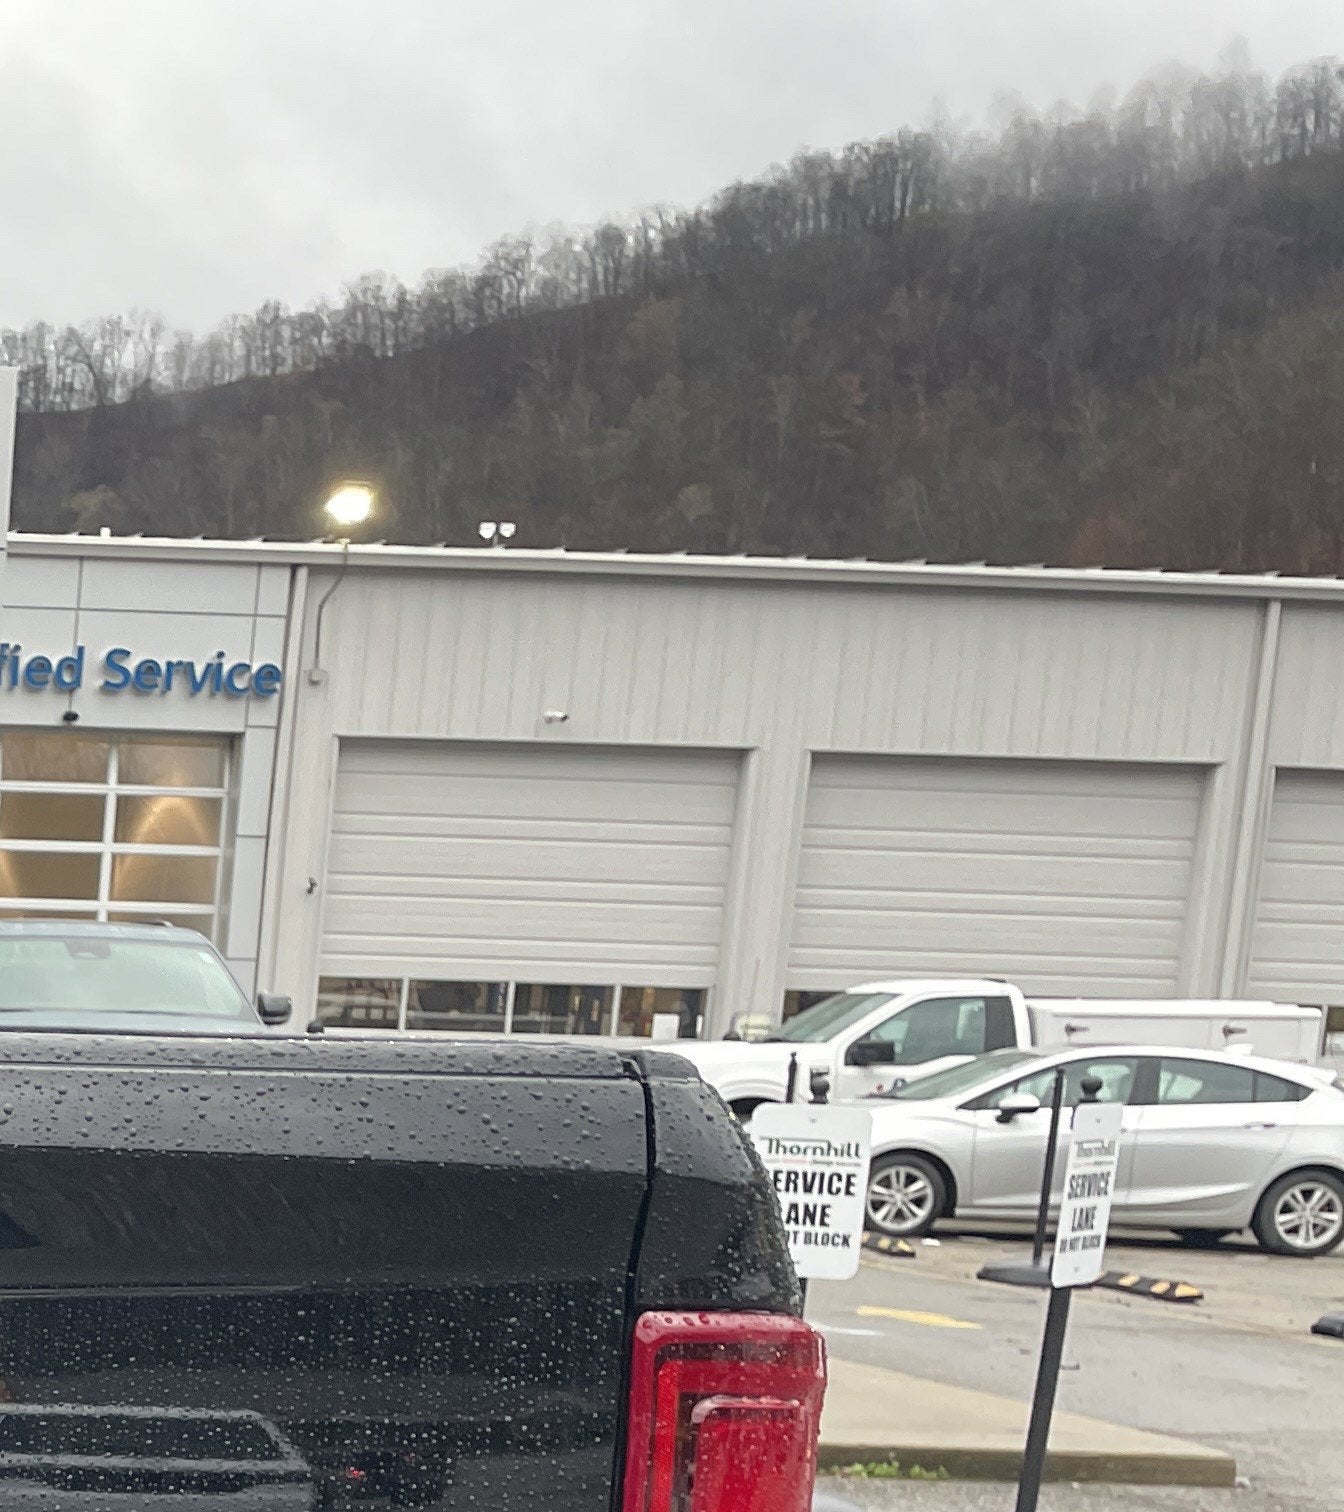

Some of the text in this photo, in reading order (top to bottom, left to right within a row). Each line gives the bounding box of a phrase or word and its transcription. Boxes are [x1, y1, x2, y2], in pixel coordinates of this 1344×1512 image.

[100, 647, 282, 697] Service
[760, 1135, 862, 1158] Thornhill
[773, 1170, 858, 1196] ERVICE
[786, 1203, 832, 1227] ANE
